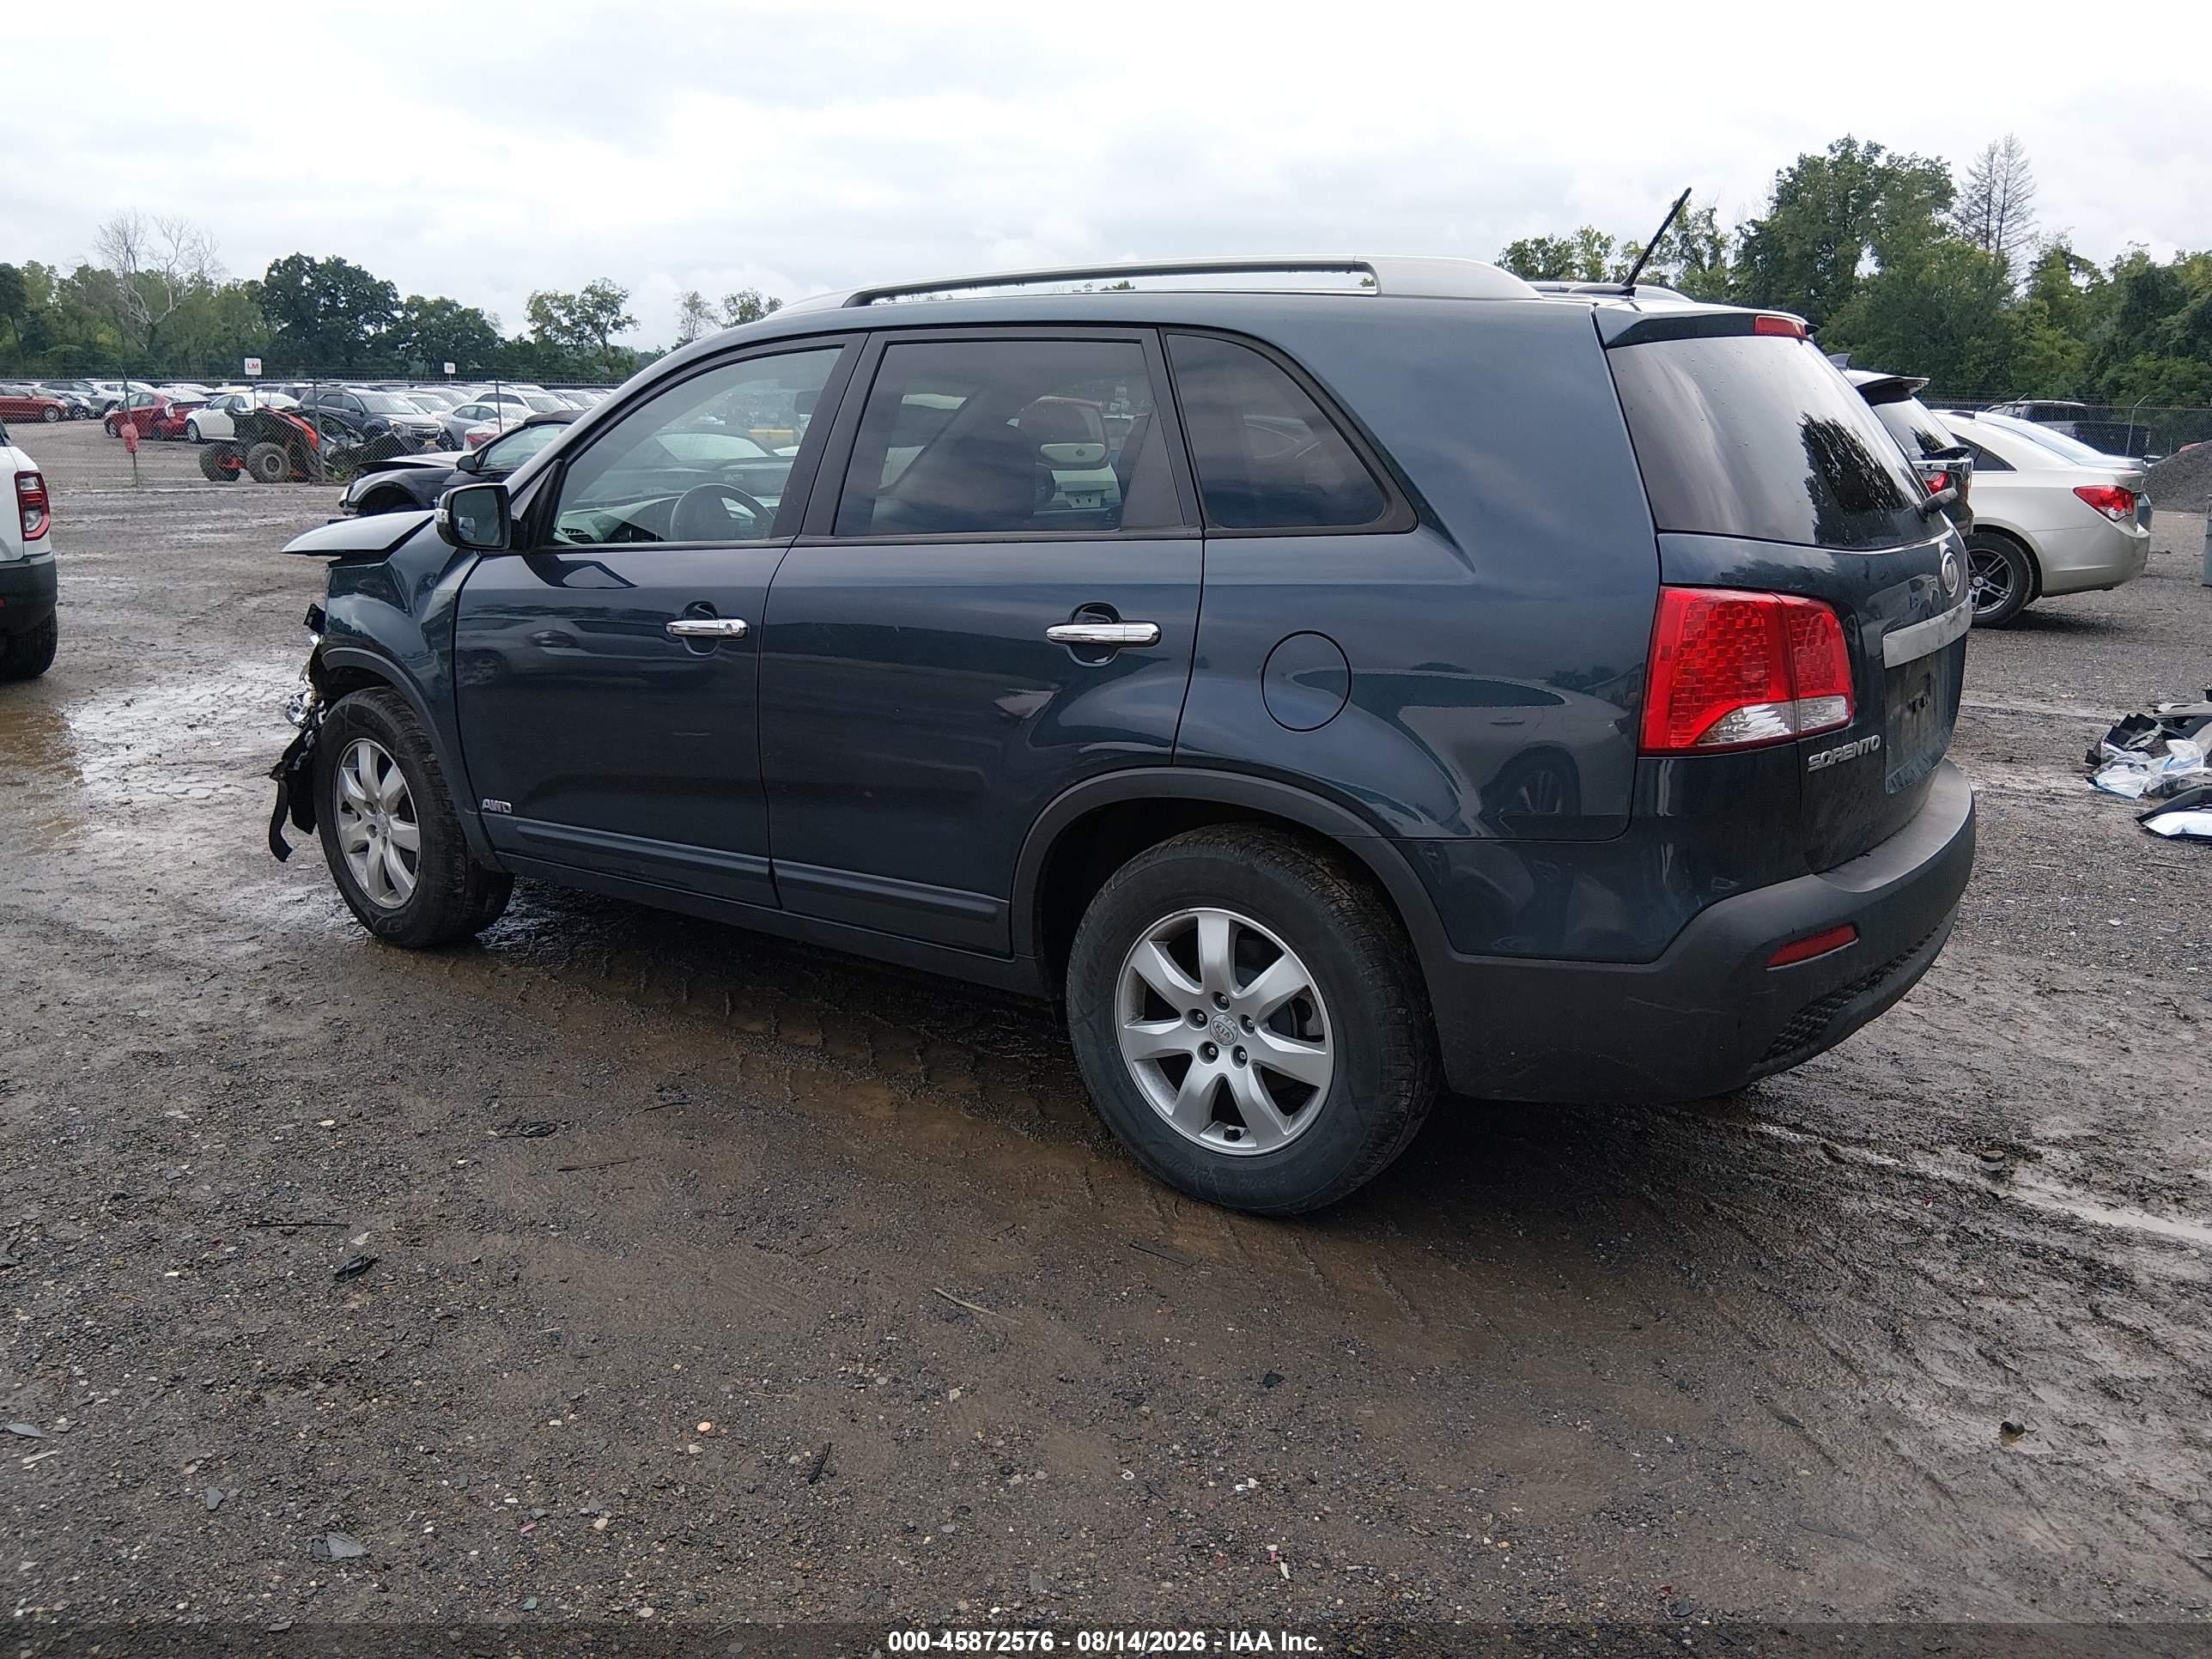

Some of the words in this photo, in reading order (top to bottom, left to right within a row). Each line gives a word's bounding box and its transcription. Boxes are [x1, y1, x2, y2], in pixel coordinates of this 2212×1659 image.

[1808, 734, 1881, 772] SORENTO
[482, 799, 513, 814] AWD
[1215, 1023, 1231, 1039] KIA
